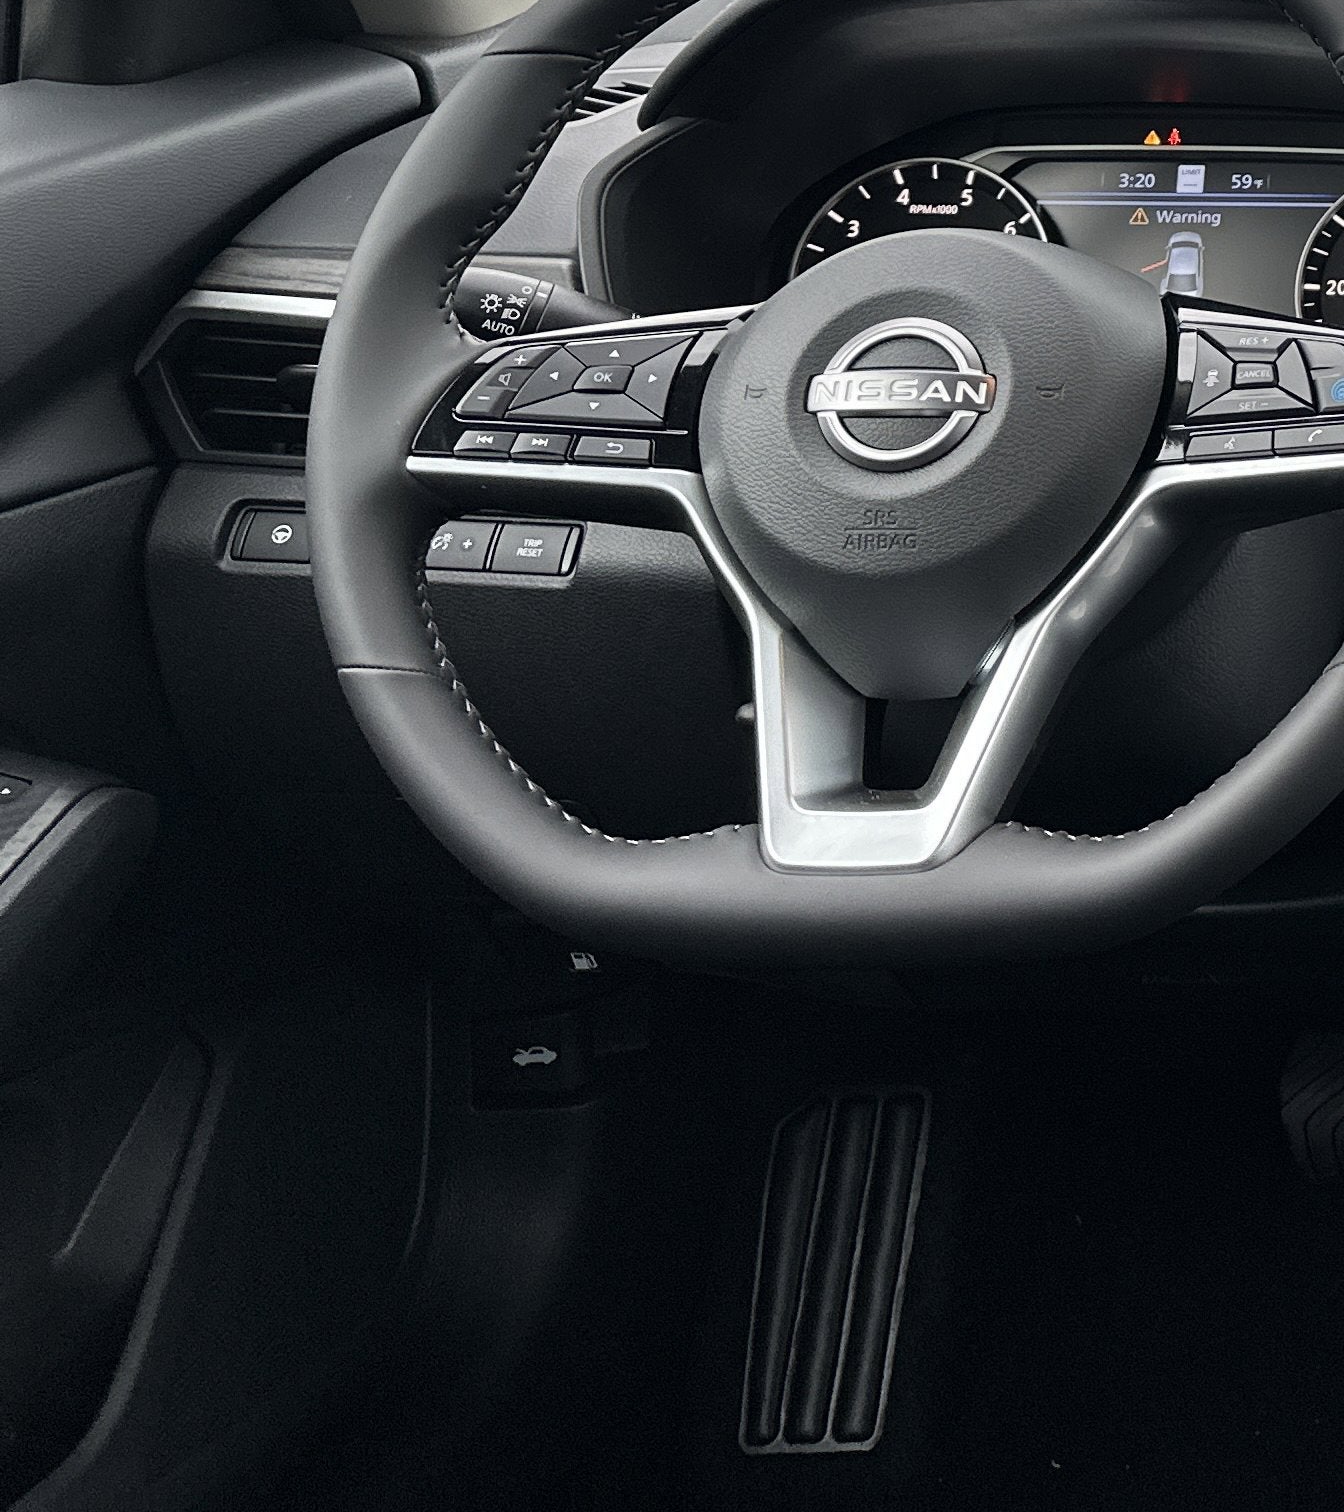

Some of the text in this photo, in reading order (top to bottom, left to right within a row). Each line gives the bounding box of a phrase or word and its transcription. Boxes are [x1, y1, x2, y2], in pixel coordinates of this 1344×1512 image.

[1118, 173, 1155, 188] 3:20
[896, 189, 910, 205] 4
[960, 190, 974, 206] 5
[1156, 211, 1222, 228] Warning
[847, 221, 861, 237] 3
[1003, 220, 1017, 235] 6
[481, 318, 515, 336] AUTO
[1239, 336, 1259, 345] RES
[593, 372, 613, 383] OK
[1237, 369, 1271, 379] CANCEL
[814, 378, 987, 405] NISSAN
[1238, 401, 1258, 410] SET
[862, 509, 899, 527] SRS
[523, 538, 543, 548] TRIP
[841, 533, 917, 551] AIRBAG
[516, 548, 544, 558] RESET
